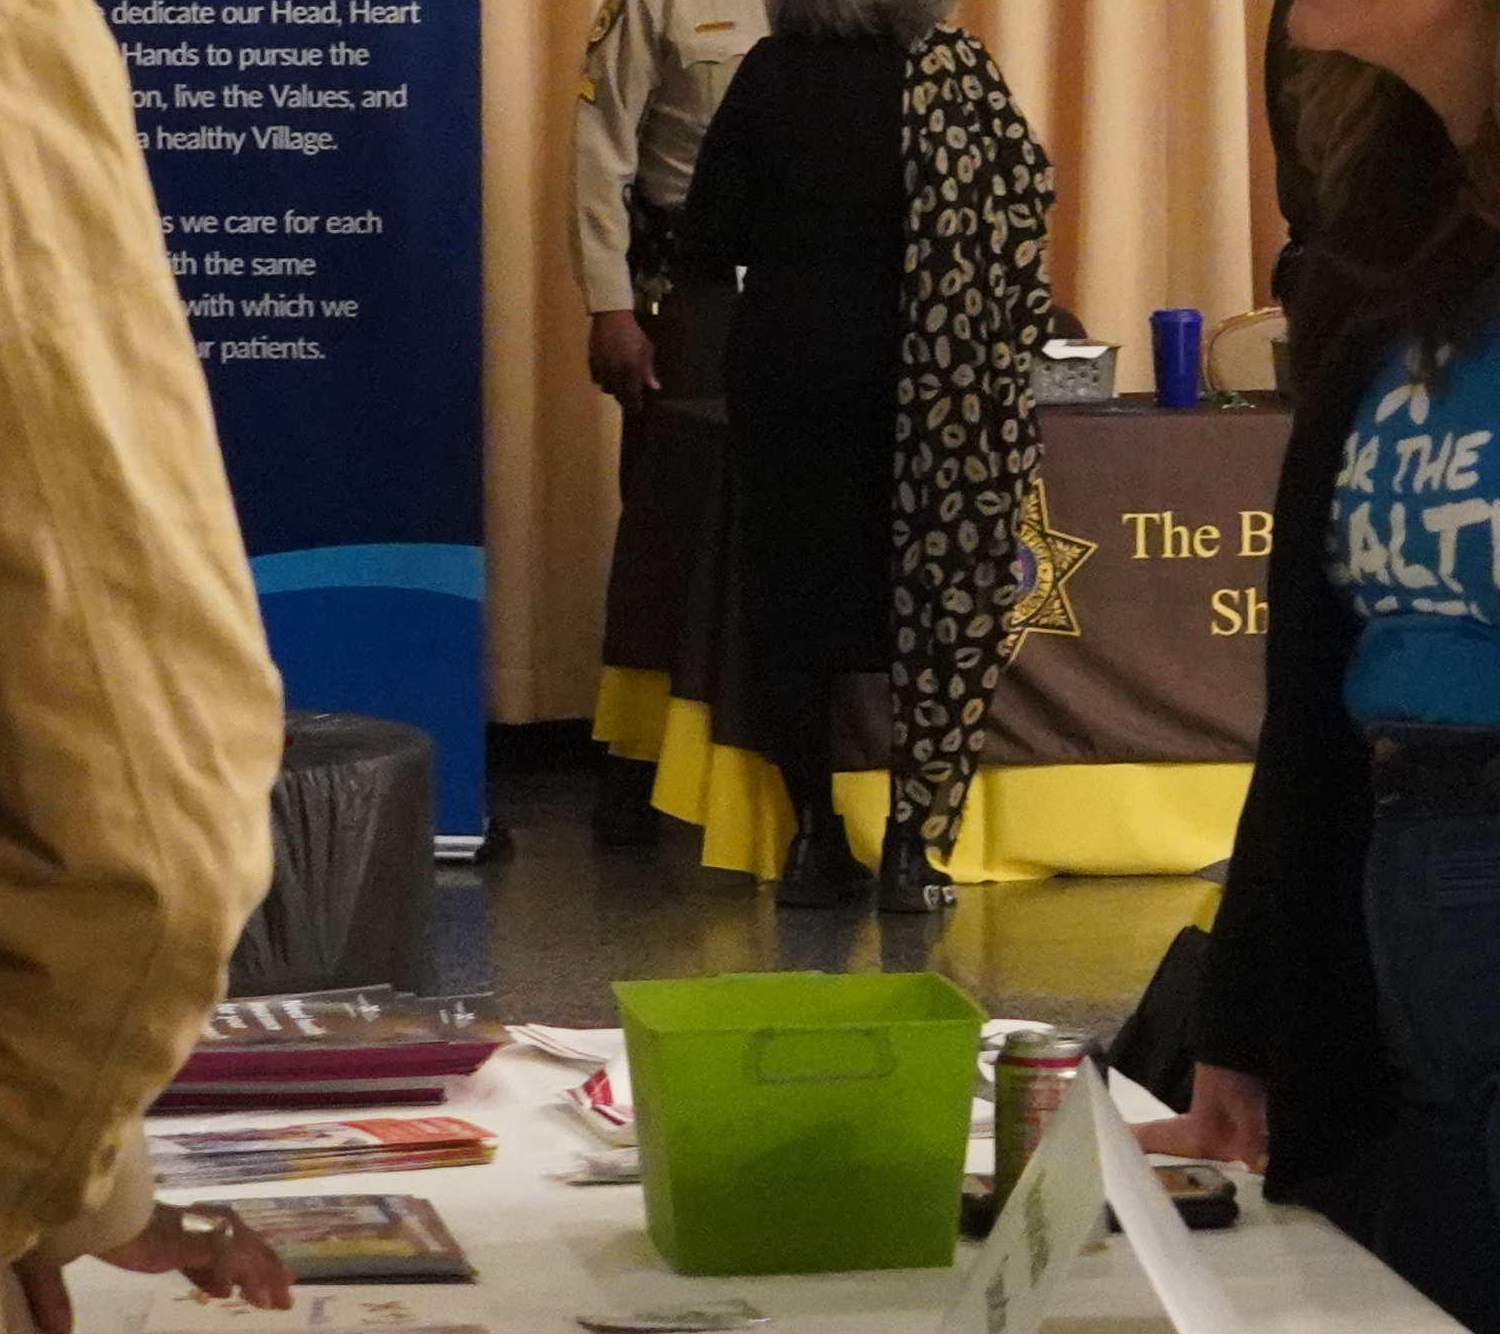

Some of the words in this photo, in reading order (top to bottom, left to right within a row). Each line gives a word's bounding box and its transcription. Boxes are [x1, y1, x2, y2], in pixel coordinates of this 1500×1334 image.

[111, 0, 216, 25] dedicate
[222, 5, 265, 25] our
[271, 0, 343, 27] Head,
[349, 0, 421, 25] Heart
[121, 42, 200, 67] Hands
[206, 44, 233, 67] to
[239, 48, 324, 71] pursue
[329, 42, 370, 67] the
[174, 84, 215, 108] live
[223, 84, 263, 108] the
[269, 84, 355, 110] Values,
[361, 84, 408, 108] and
[156, 126, 247, 155] healthy
[252, 125, 339, 156] Village.
[181, 215, 219, 234] we
[224, 215, 277, 234] care
[284, 209, 319, 234] for
[326, 210, 384, 234] each
[166, 251, 197, 276] ith
[204, 251, 245, 276] the
[251, 256, 317, 276] same
[181, 293, 235, 318] with
[241, 293, 314, 318] which
[320, 298, 359, 318] we
[221, 335, 327, 365] patients.
[1395, 429, 1494, 494] THE
[1121, 510, 1222, 560] The
[1237, 510, 1274, 559] B
[1209, 585, 1270, 637] Sh
